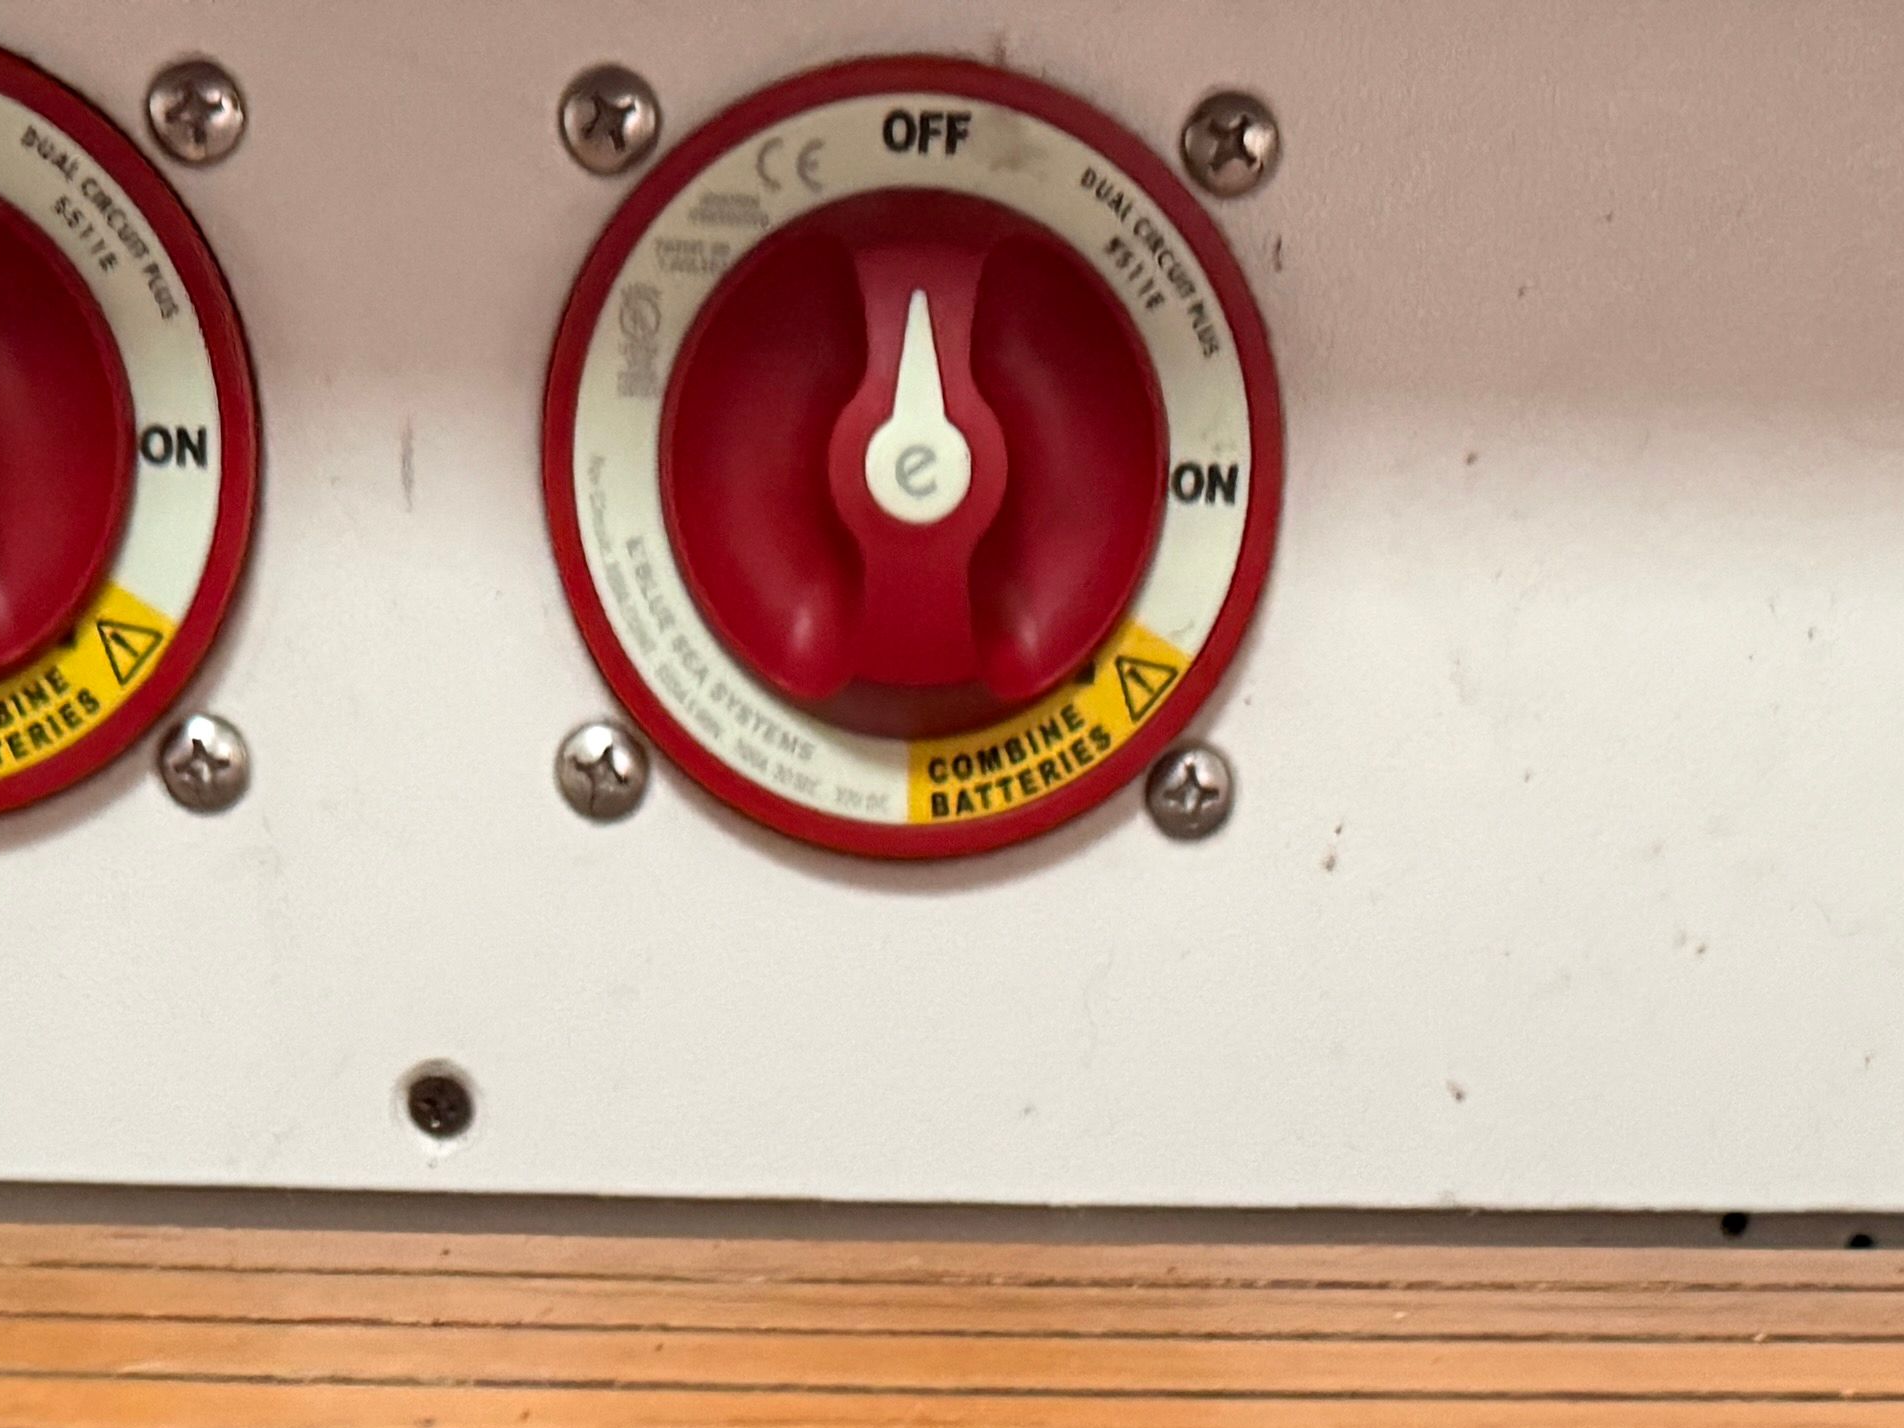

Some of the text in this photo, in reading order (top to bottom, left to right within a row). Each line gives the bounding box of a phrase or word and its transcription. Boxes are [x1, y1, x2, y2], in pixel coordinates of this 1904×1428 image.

[755, 136, 827, 193] CE
[882, 108, 972, 155] OFF
[20, 125, 180, 320] DUAL CIRCUIT PLUS
[1080, 167, 1220, 358] DUAL CIRCUIT PLUS
[140, 424, 208, 469] ON
[895, 443, 938, 498] e
[1171, 462, 1239, 507] ON
[709, 682, 817, 762] SYSTEMS
[927, 703, 1085, 784] COMBINE
[930, 724, 1112, 817] BATTERIES
